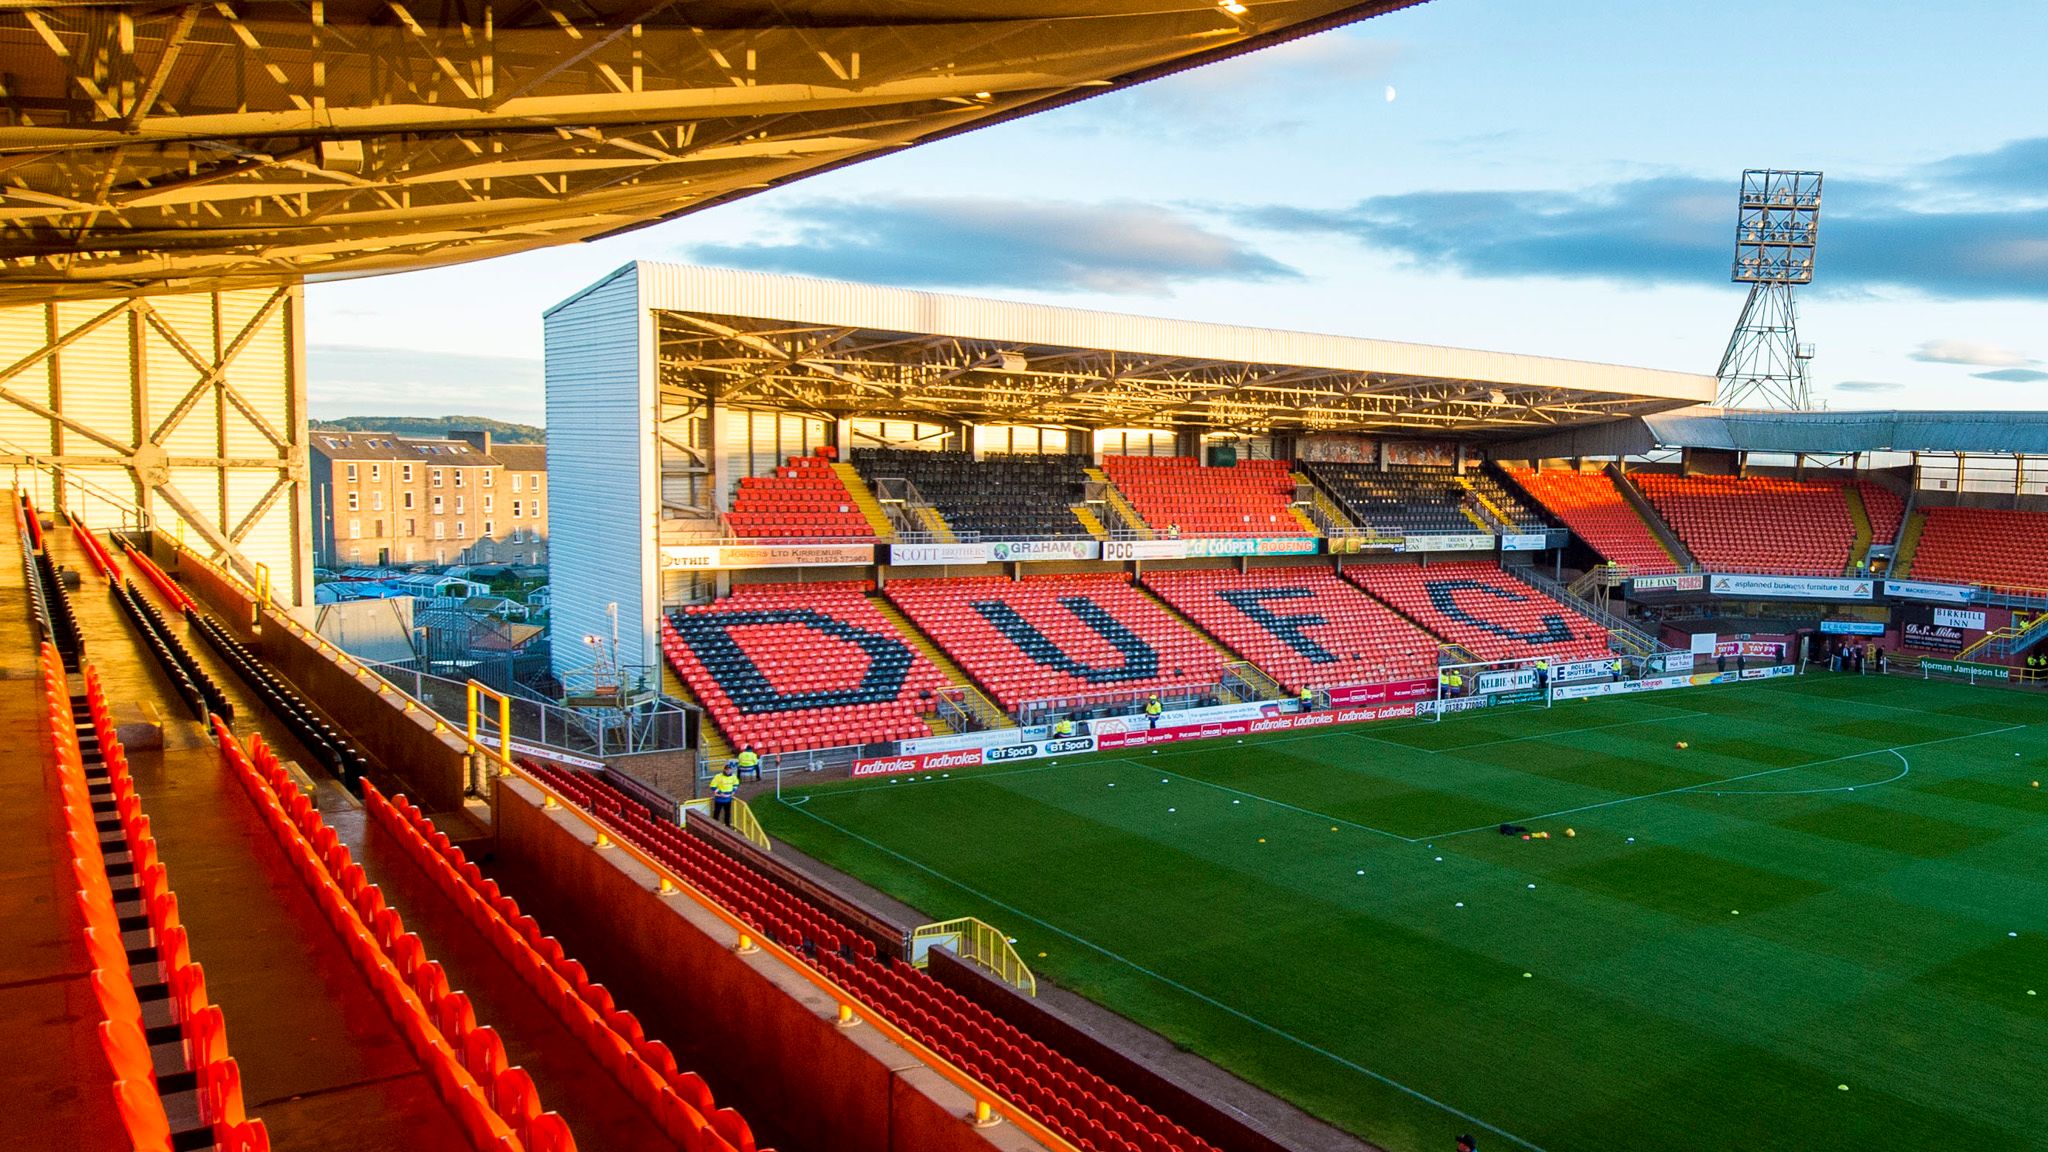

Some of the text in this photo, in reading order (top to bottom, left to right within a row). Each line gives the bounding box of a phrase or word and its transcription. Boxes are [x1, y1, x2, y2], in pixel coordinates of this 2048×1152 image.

[1011, 542, 1071, 553] GRAHAM
[1107, 543, 1133, 559] PCC
[1208, 540, 1255, 553] COOPER
[1261, 541, 1312, 551] ROOFING
[661, 551, 710, 567] DUTHIE
[893, 547, 985, 561] SCOTT BROTHERS
[1657, 577, 1677, 587] TAXIS
[1807, 583, 1838, 591] furniture
[1936, 608, 1982, 620] BIRKHILL
[1949, 619, 1969, 627] INN
[1931, 626, 1962, 639] Milne
[1567, 668, 1596, 677] SHUTTERS
[1571, 663, 1592, 671] ROLLER
[1921, 660, 2009, 678] Norman Jamieson Ltd
[1481, 677, 1506, 689] KELBIE
[1623, 681, 1640, 689] Evening
[1641, 679, 1663, 687] Telegraph
[1446, 702, 1463, 712] 01382
[1250, 706, 1414, 732] Ladbrokes Ladbrokes Ladbrokes Ladbrokes
[1050, 739, 1090, 752] BT Sport
[992, 746, 1033, 759] BT Sport
[854, 751, 981, 776] Ladbrokes Ladbrokes
